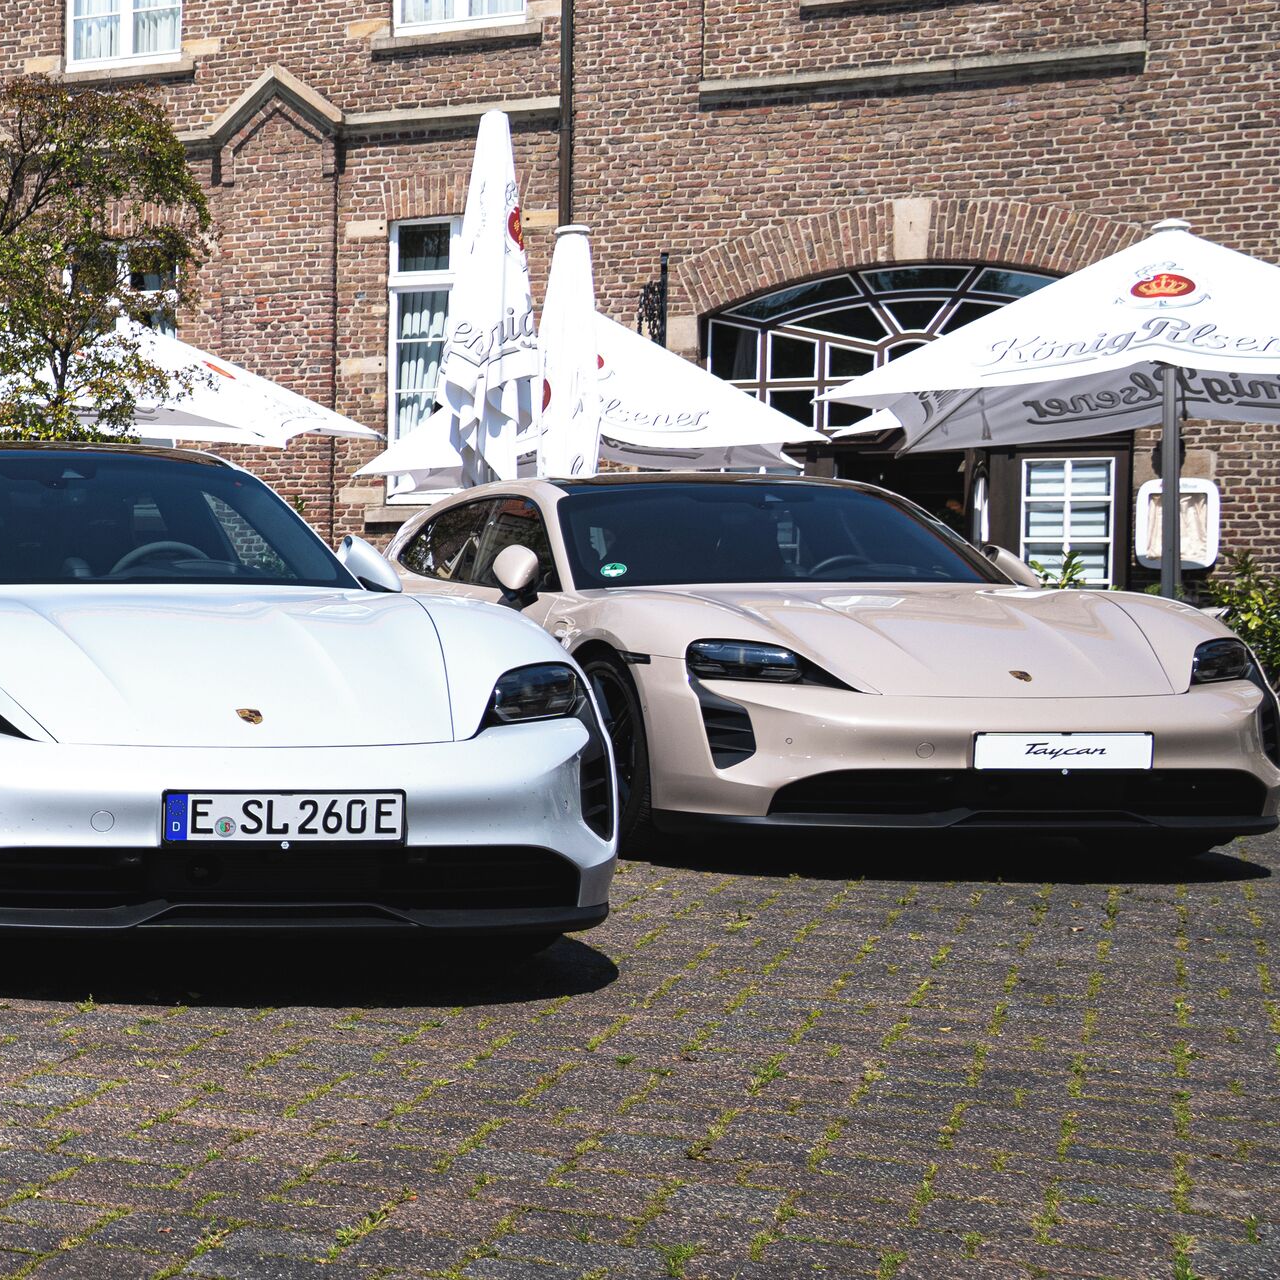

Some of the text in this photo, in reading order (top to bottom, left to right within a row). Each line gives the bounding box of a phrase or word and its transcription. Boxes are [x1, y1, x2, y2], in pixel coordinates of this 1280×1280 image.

[976, 316, 1280, 367] König Pilsen
[1024, 742, 1107, 760] Taycan
[171, 821, 181, 832] D
[190, 799, 214, 835] E
[240, 799, 290, 835] SL
